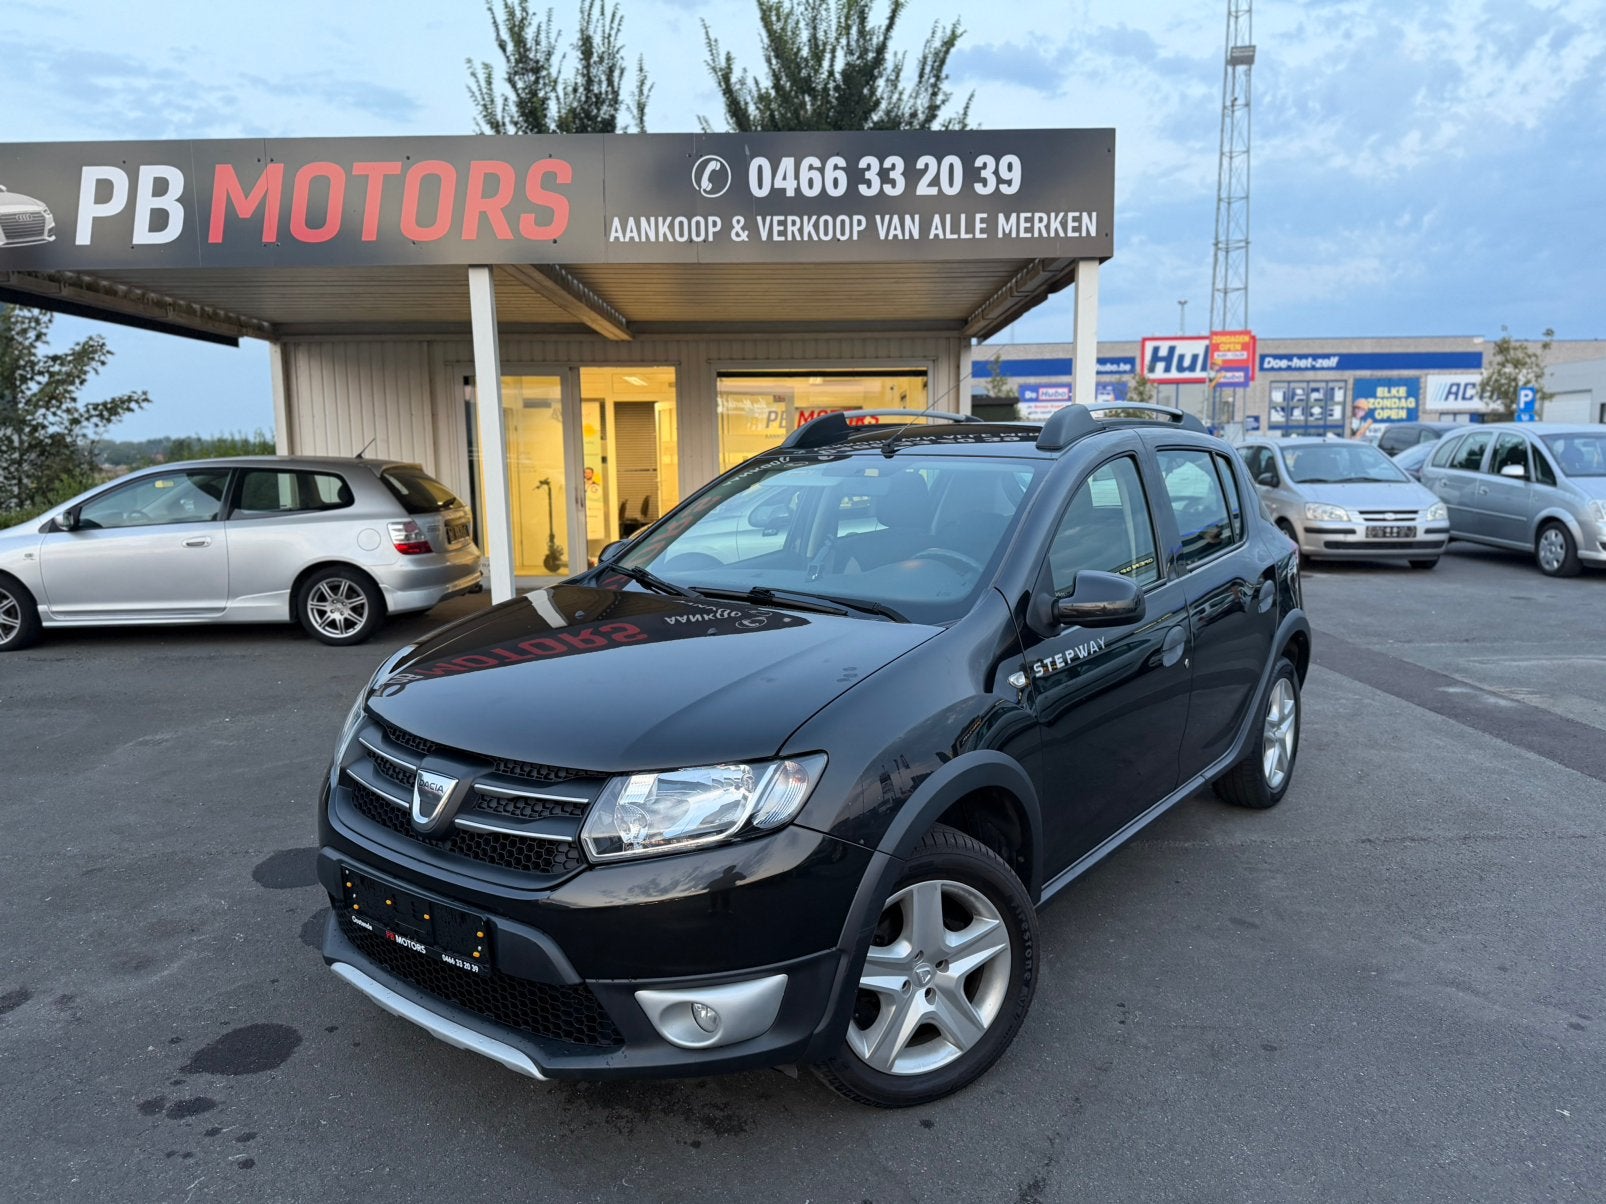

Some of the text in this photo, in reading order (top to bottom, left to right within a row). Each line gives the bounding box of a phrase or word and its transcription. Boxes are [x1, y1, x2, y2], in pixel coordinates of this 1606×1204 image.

[749, 154, 1022, 198] 0466 33 20 39
[75, 158, 573, 245] PB MOTORS
[609, 211, 1098, 242] AANKOOP & VERKOOP VAN ALLE MERKEN
[1263, 356, 1340, 370] Doe-het-zelf
[1376, 386, 1408, 397] ELKE
[1520, 389, 1534, 409] P
[1367, 397, 1416, 409] ZONDAG
[1374, 408, 1407, 420] OPEN
[1033, 636, 1106, 678] STEPWAY
[418, 778, 444, 793] DACIA
[395, 934, 426, 954] MOTORS
